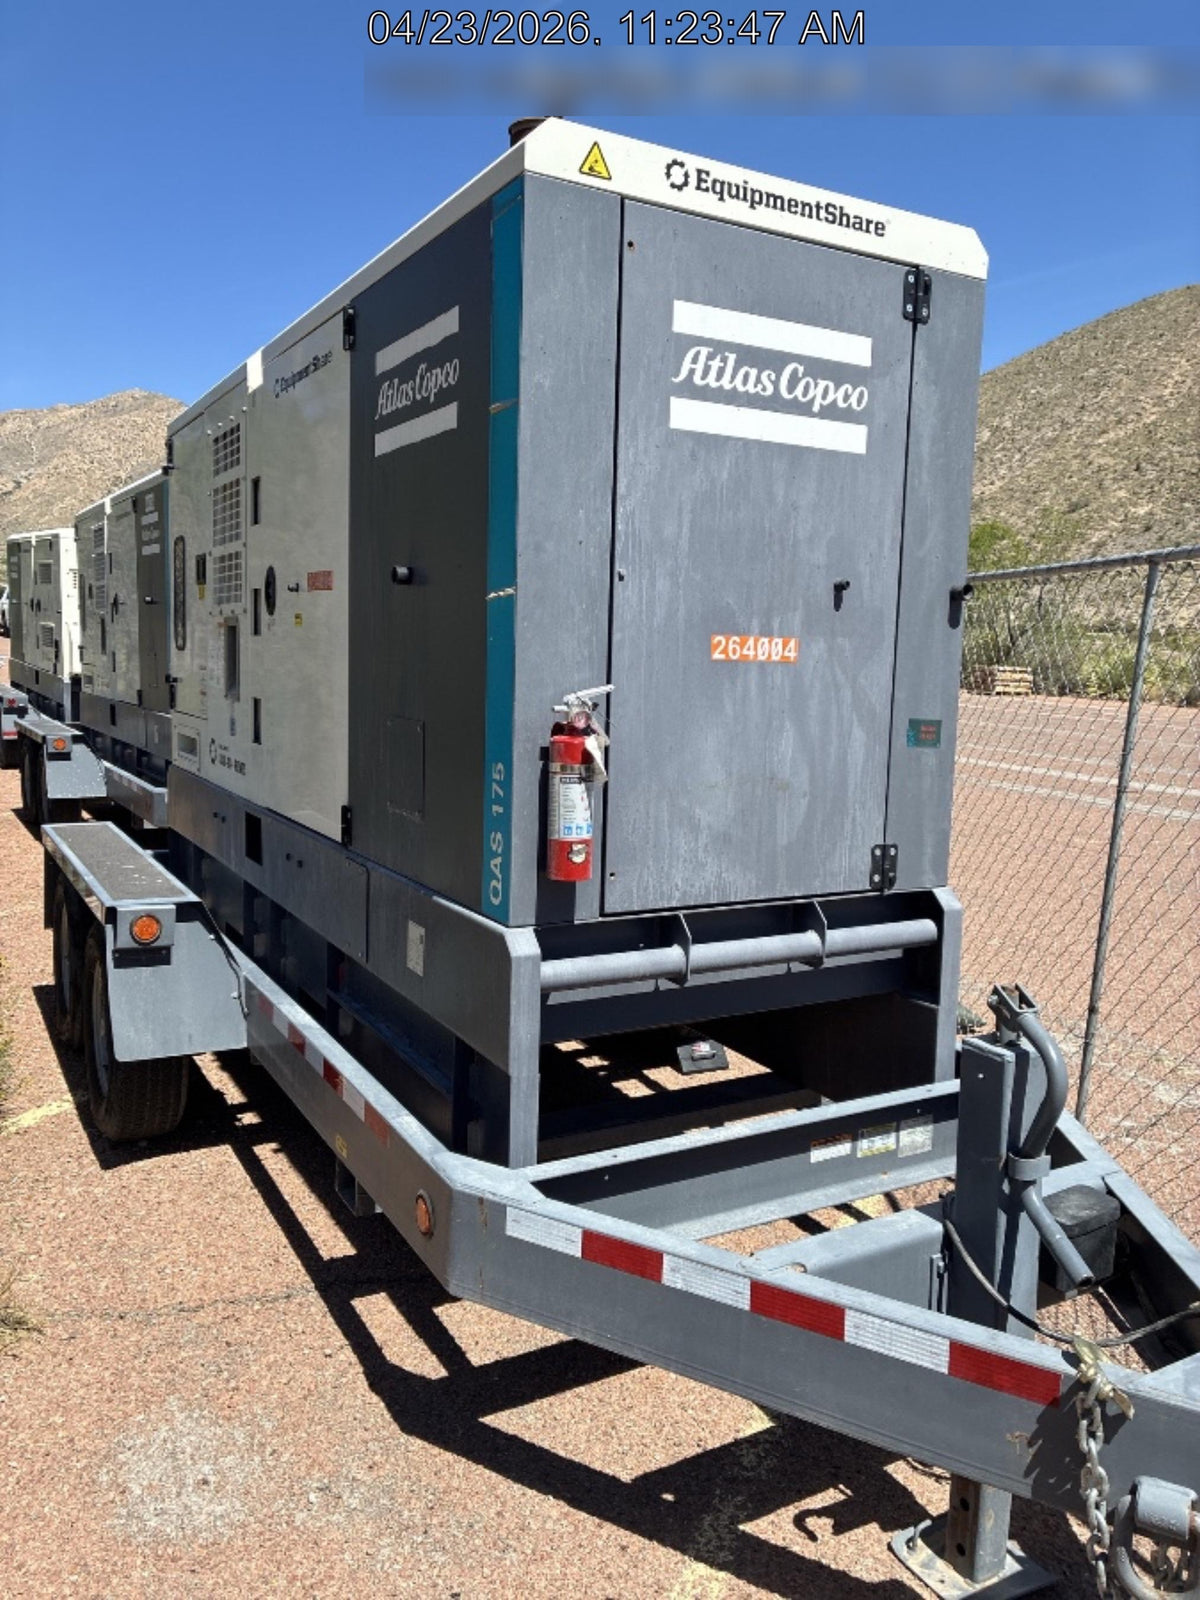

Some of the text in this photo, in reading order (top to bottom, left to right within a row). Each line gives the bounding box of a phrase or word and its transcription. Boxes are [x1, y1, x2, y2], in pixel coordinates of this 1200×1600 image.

[694, 168, 886, 237] EquipmentShare
[374, 358, 460, 421] Atlas Copco
[672, 345, 869, 413] Atlas Copco
[711, 635, 798, 661] 264004
[489, 761, 505, 906] QAS 175
